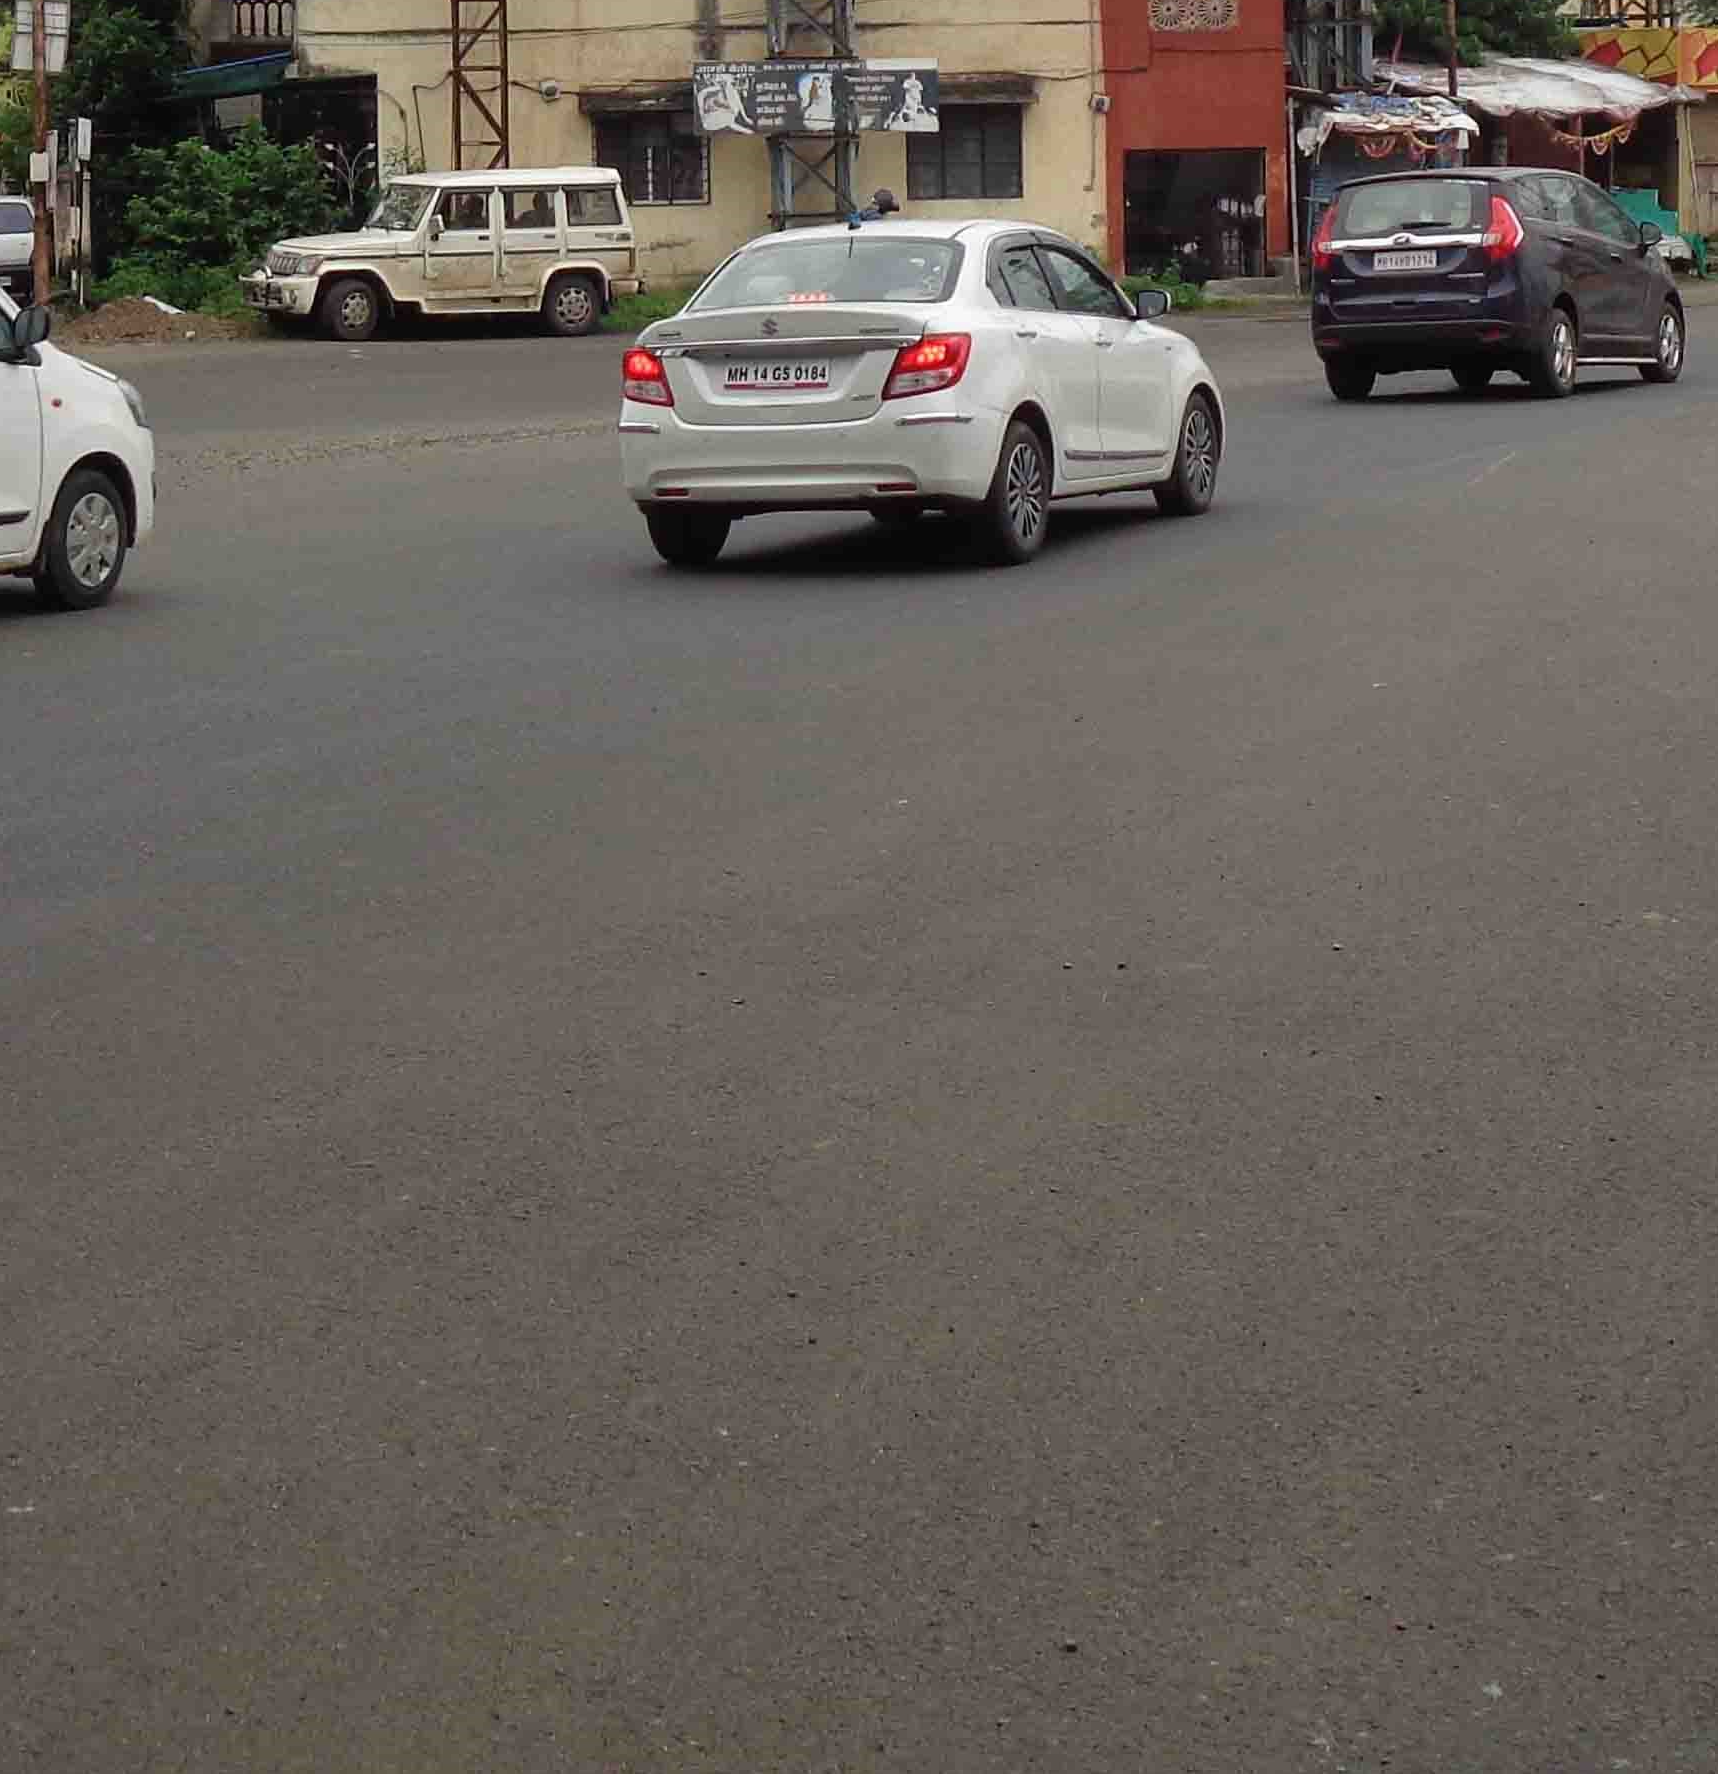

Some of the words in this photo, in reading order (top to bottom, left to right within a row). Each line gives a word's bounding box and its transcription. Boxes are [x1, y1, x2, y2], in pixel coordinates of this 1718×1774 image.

[727, 366, 748, 382] MH
[752, 366, 768, 381] 14
[794, 365, 827, 380] 0184
